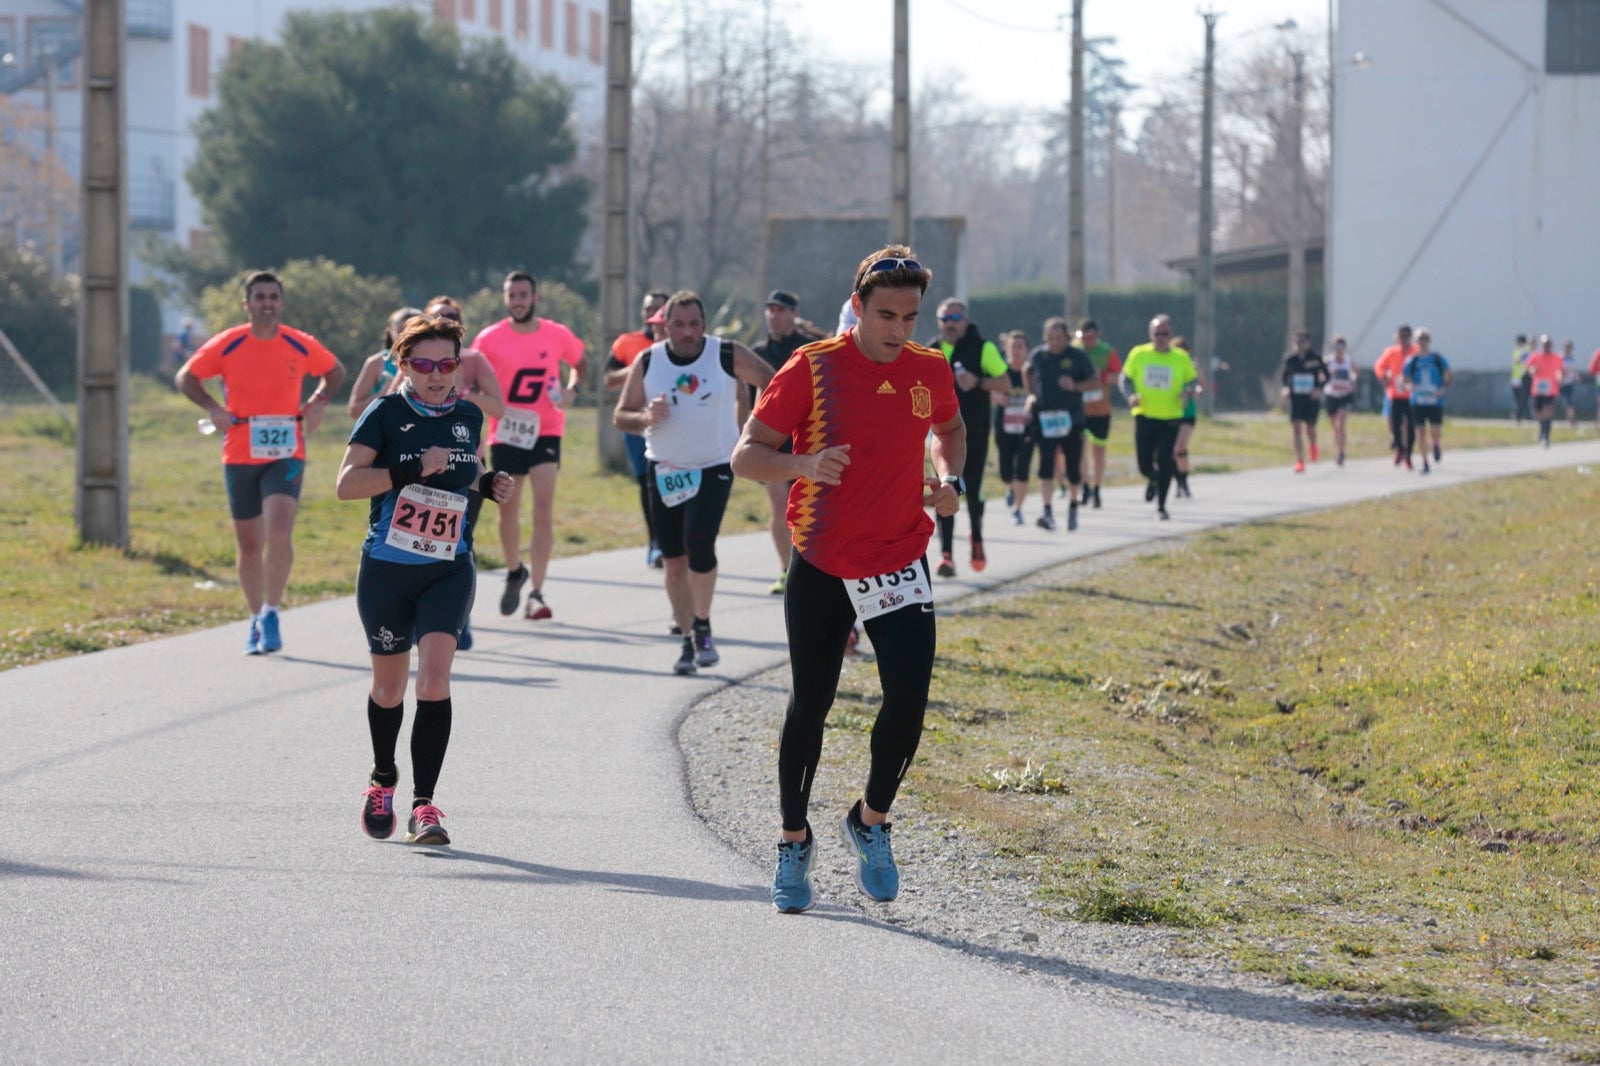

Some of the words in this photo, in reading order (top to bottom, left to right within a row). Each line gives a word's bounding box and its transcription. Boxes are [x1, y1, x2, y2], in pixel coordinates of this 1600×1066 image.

[507, 367, 547, 405] G
[258, 428, 289, 445] 321
[664, 472, 693, 492] 801
[396, 503, 458, 539] 2151
